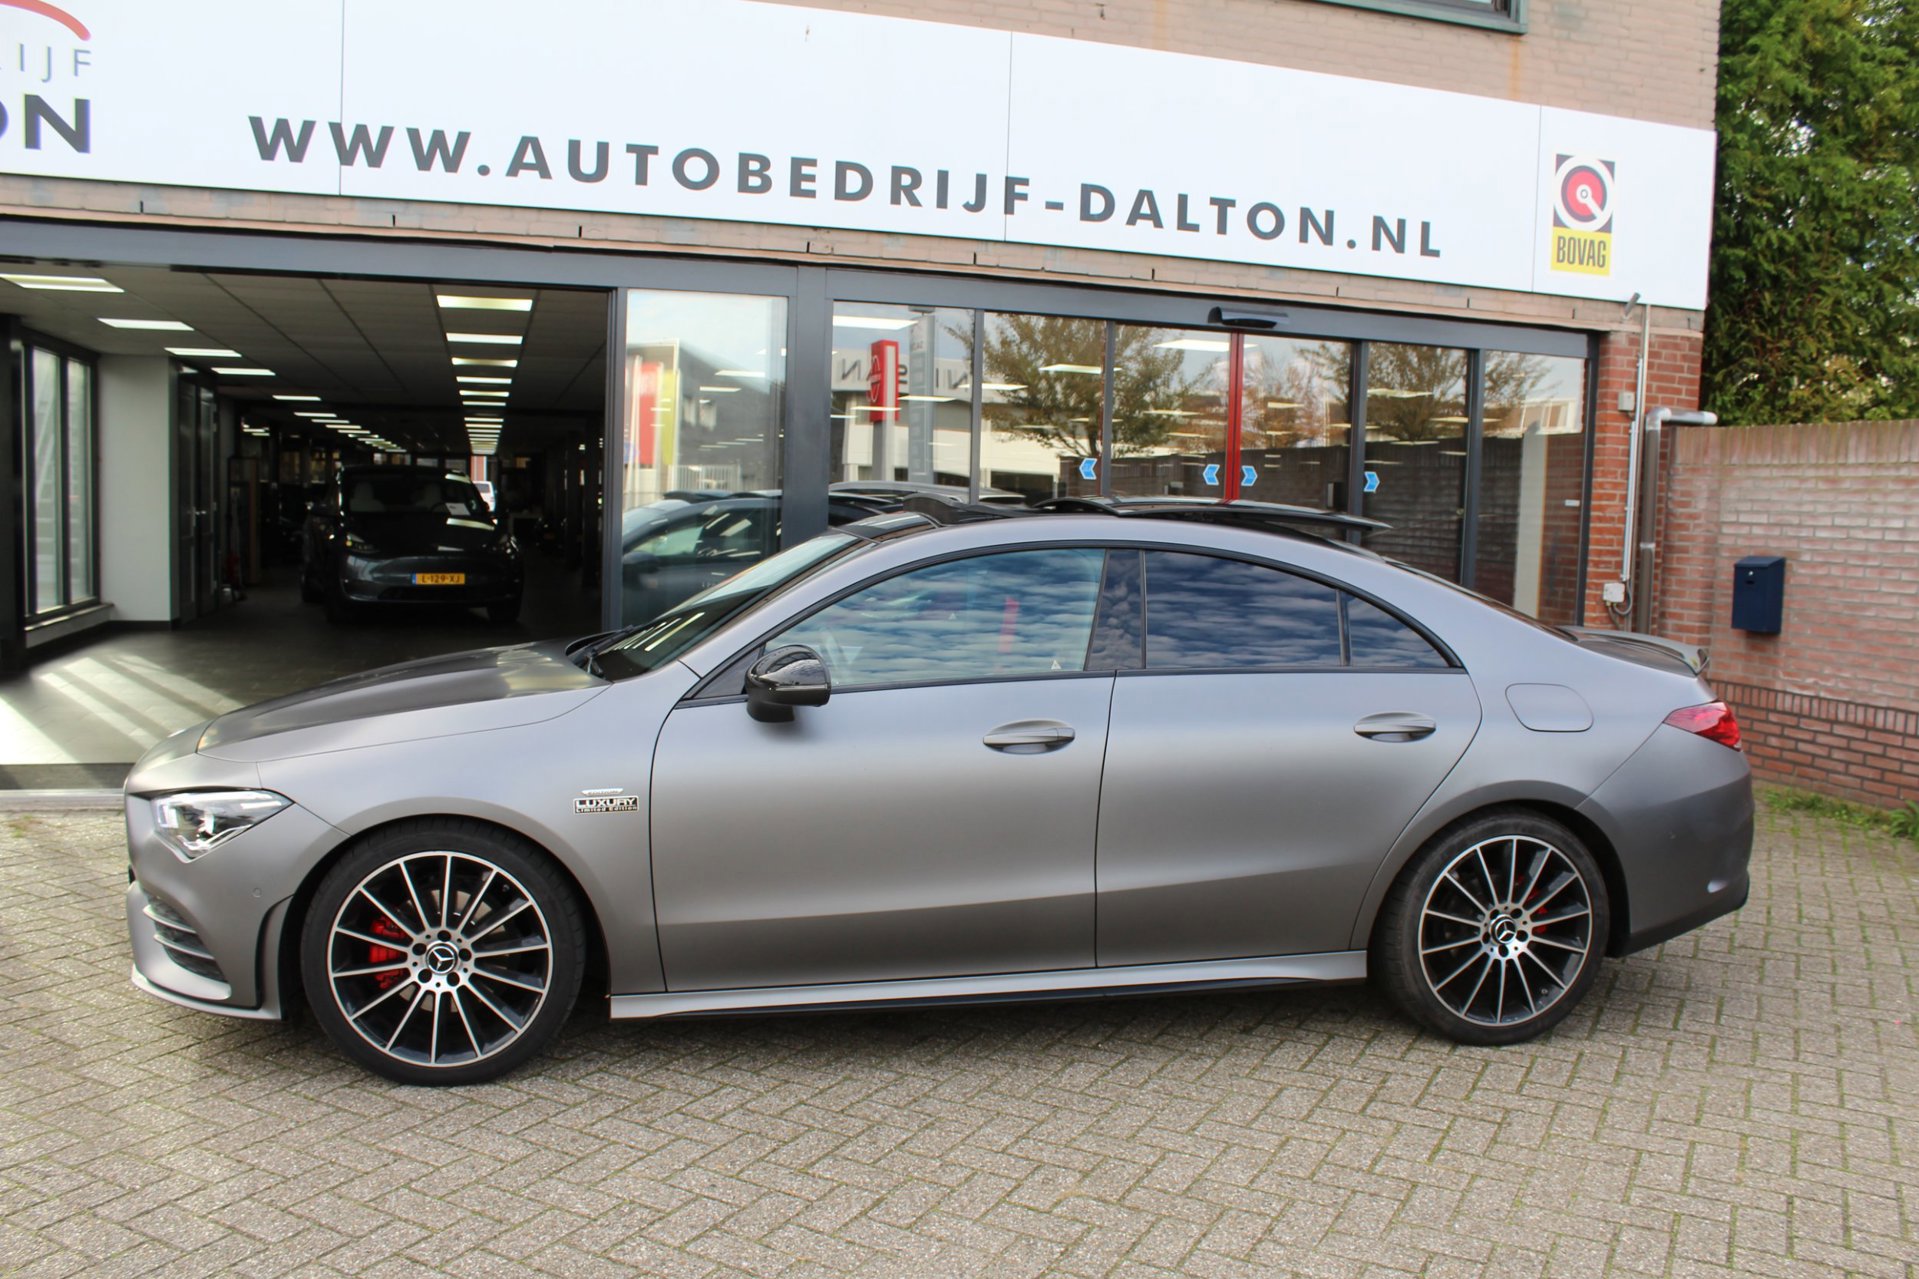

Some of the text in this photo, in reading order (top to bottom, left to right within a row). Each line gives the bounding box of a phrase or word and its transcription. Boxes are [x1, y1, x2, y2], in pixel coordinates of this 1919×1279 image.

[0, 43, 91, 83] IJF
[0, 93, 90, 154] N
[248, 115, 1441, 257] WWW.AUTOBEDRIJF-DALTON.NL
[1556, 235, 1607, 268] BOVAG
[576, 798, 636, 808] LUXURY
